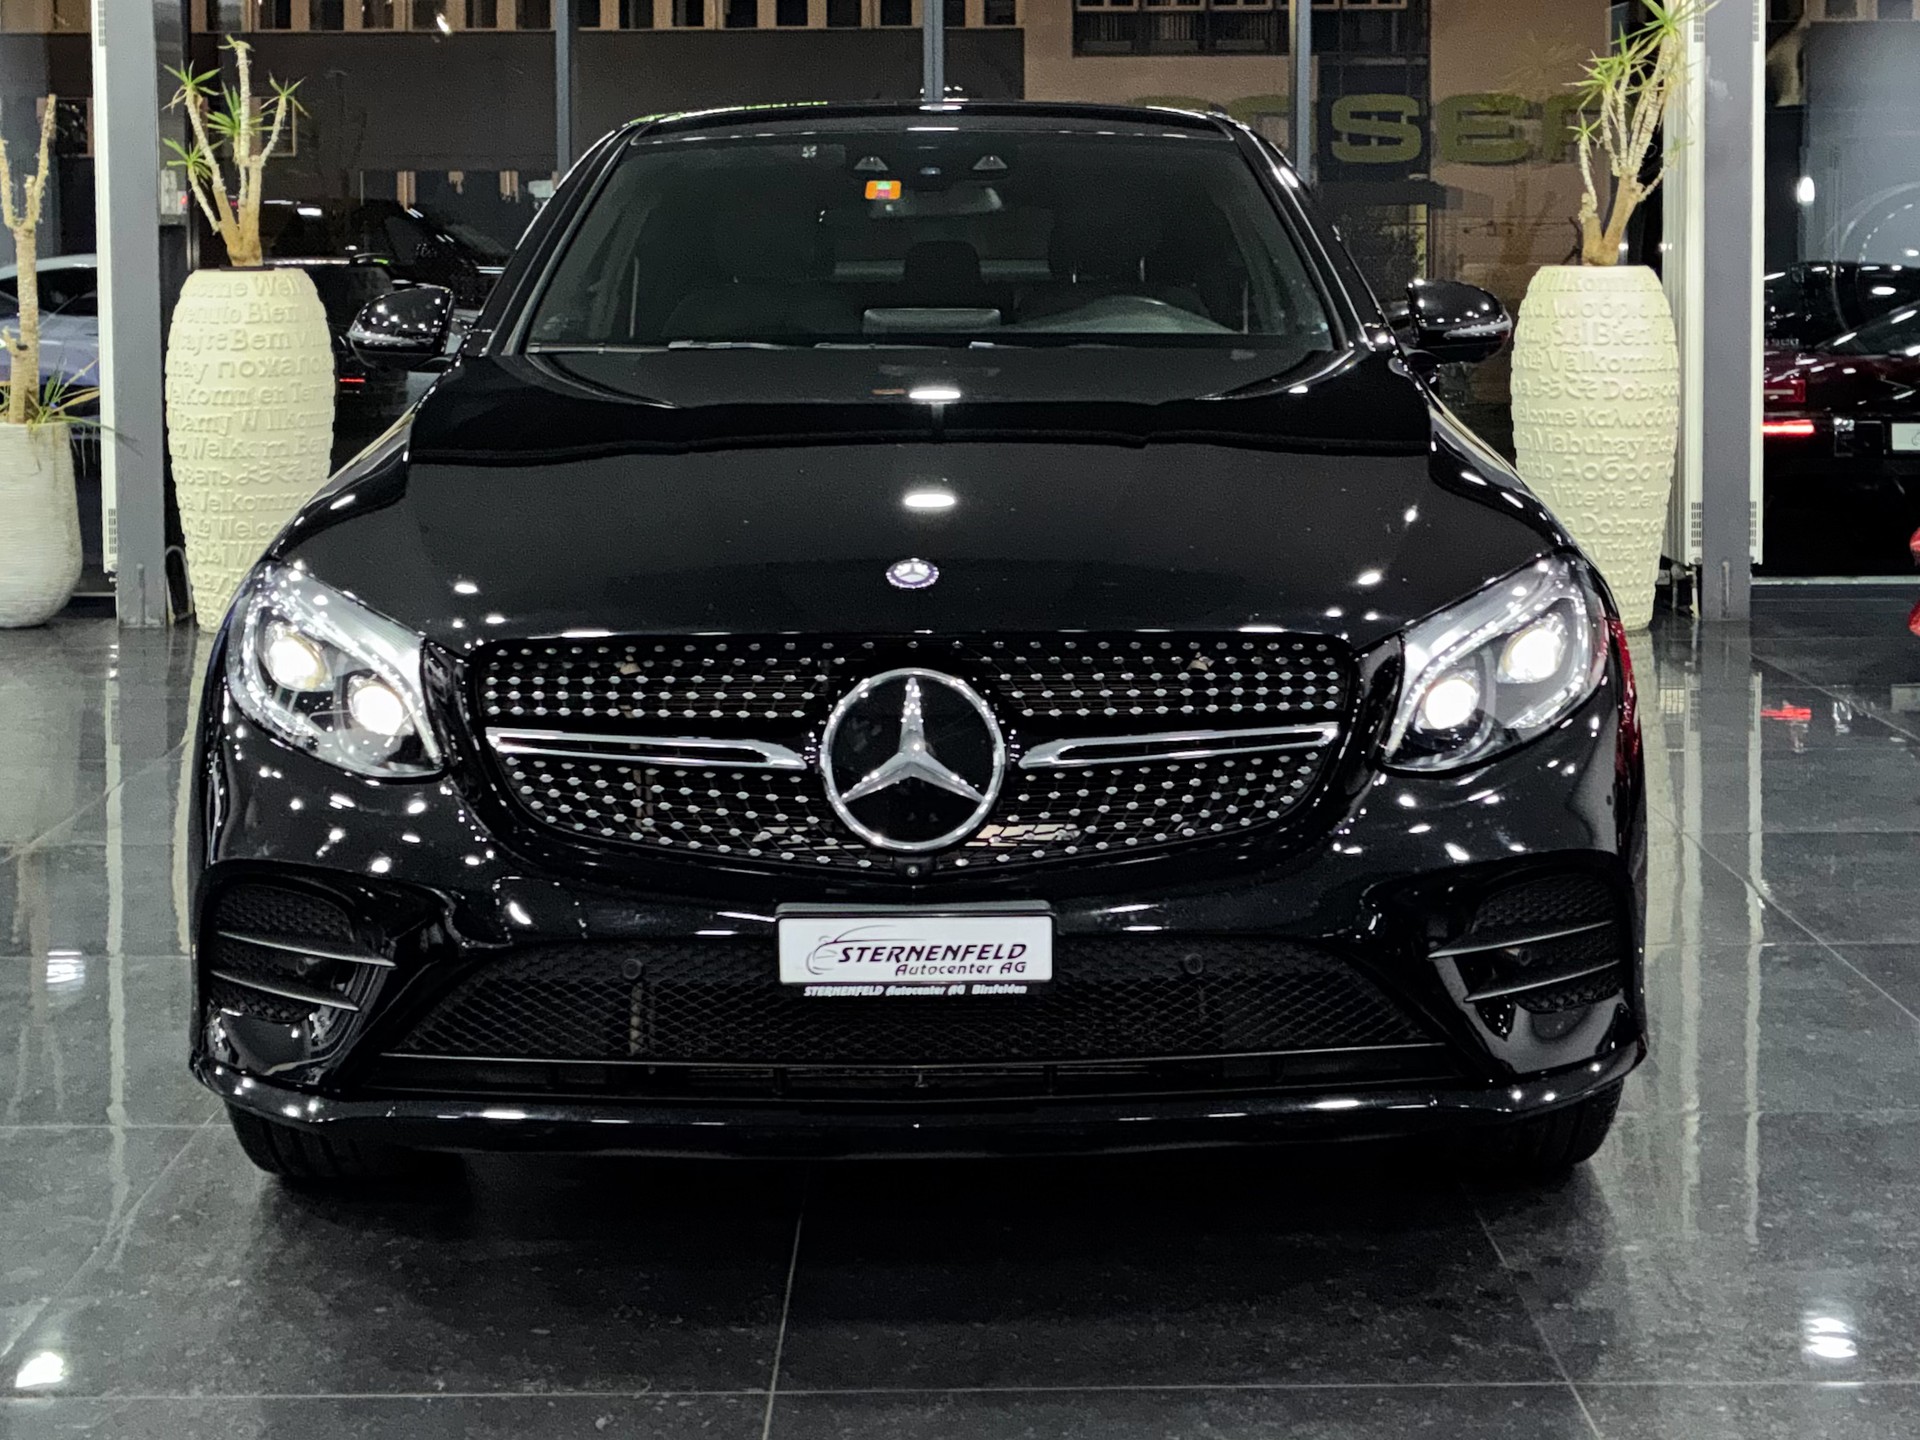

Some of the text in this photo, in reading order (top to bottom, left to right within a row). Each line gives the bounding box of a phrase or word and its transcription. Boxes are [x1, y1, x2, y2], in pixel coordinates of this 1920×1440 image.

[838, 943, 1028, 963] STERNENFELD
[894, 961, 1027, 977] Autocenter AG
